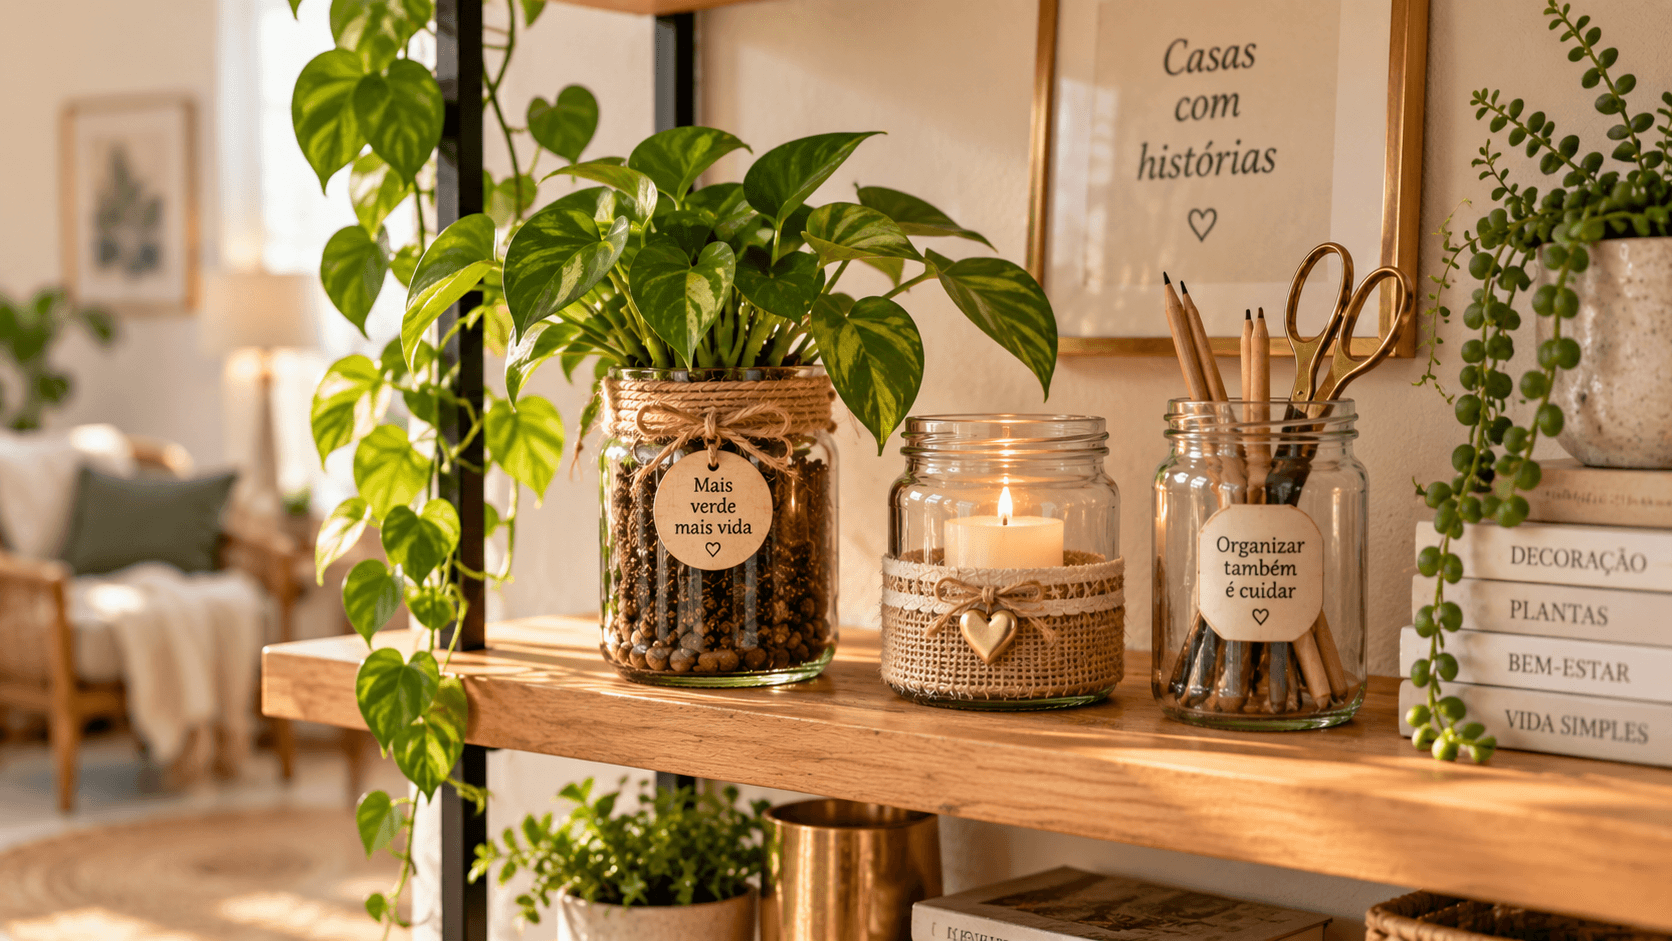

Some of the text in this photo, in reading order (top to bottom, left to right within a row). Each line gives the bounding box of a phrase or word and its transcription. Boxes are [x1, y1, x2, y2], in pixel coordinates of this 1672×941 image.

[1163, 37, 1258, 76] Casas
[1174, 92, 1241, 122] com
[1136, 139, 1278, 181] histórias
[693, 477, 733, 493] Mais
[690, 497, 736, 514] verde
[674, 518, 752, 535] mais vida
[1216, 535, 1305, 558] Organizar
[1224, 558, 1298, 576] também
[1510, 545, 1648, 577] DECORAÇÃO
[1225, 580, 1297, 599] é cuidar
[1509, 599, 1609, 627] PLANTAS
[1507, 652, 1631, 684] BEM-ESTAR
[1505, 709, 1650, 745] VIDA SIMPLES
